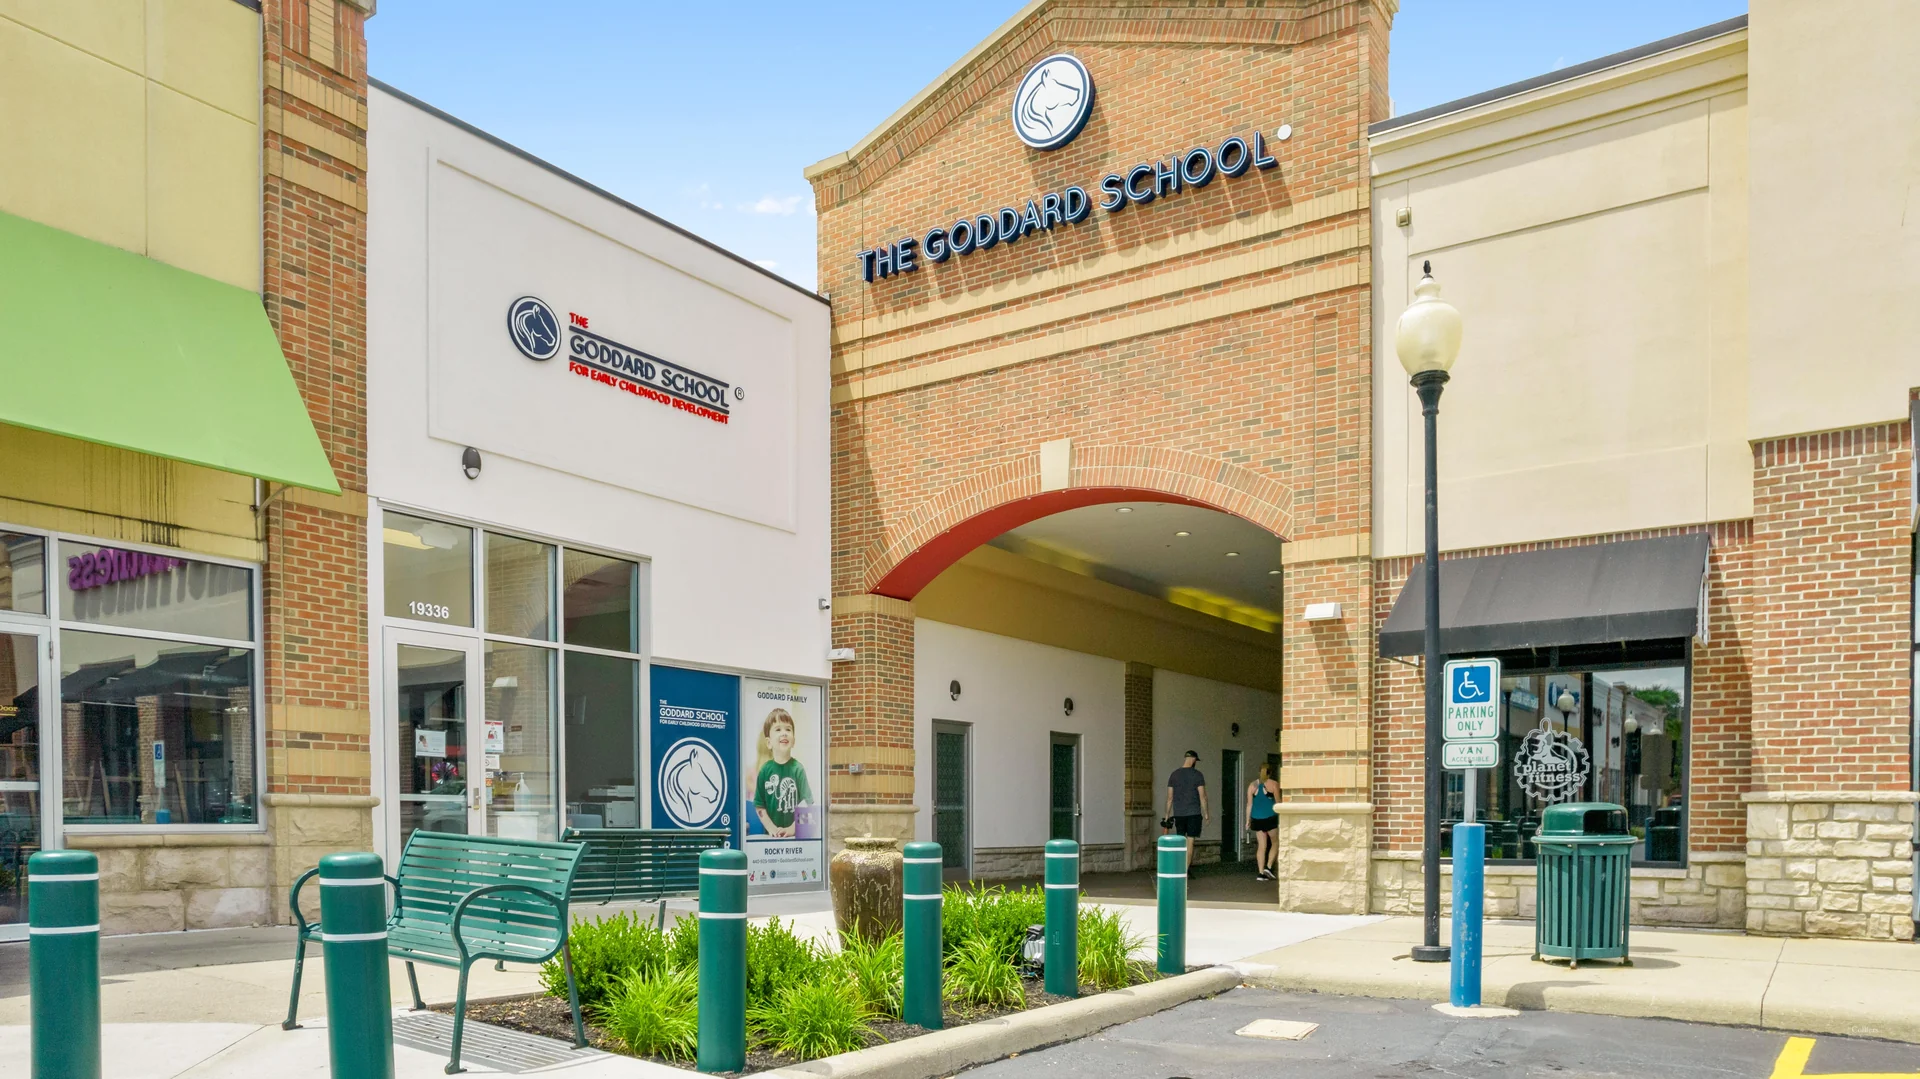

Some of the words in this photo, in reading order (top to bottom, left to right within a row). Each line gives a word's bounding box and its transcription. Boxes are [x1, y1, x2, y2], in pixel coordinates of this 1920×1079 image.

[856, 236, 916, 283] THE
[922, 185, 1092, 263] GODDARD
[1100, 130, 1278, 213] SCHOOL
[569, 312, 589, 328] THE
[570, 334, 656, 380] GODDARD
[661, 368, 729, 407] SCHOOL
[569, 361, 589, 377] FOR
[590, 369, 618, 387] EARLY
[618, 379, 671, 405] CHILDHOOD
[672, 397, 729, 425] DEVELOPMENT
[409, 600, 450, 619] 19336
[757, 691, 786, 701] GODDARD
[659, 707, 695, 719] GODDARD
[695, 710, 726, 722] SCHOOL
[1447, 705, 1495, 719] PARKING
[1457, 720, 1484, 731] ONLY
[1458, 746, 1484, 755] VAN
[1522, 760, 1572, 775] planet
[1528, 771, 1582, 783] fitness
[764, 847, 785, 856] ROCKY
[785, 847, 803, 855] RIVER
